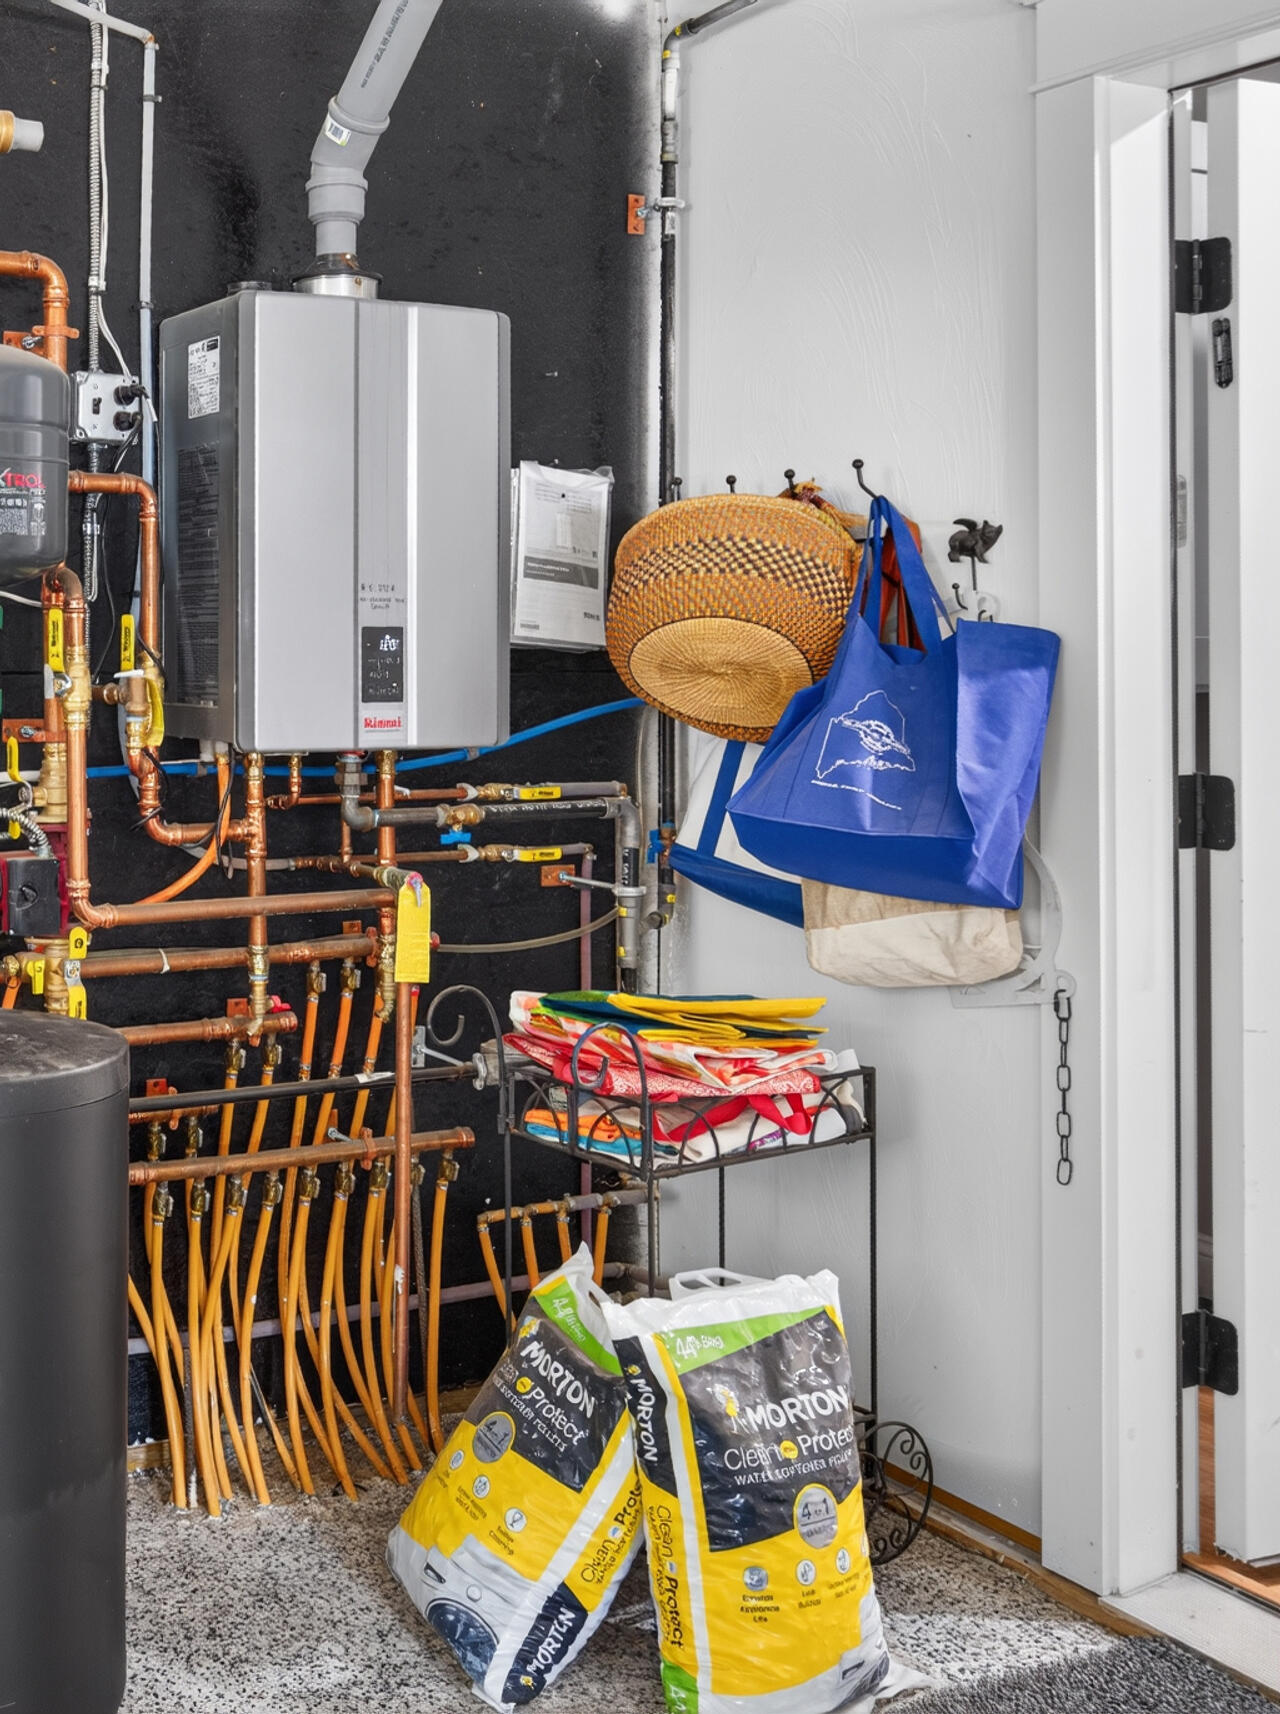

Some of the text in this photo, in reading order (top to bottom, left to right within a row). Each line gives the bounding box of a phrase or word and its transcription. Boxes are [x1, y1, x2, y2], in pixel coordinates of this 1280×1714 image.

[363, 716, 402, 729] Rinnai
[521, 1340, 596, 1418] MORTON
[744, 1386, 849, 1432] MORTON
[524, 1382, 588, 1446] Protect
[629, 1377, 659, 1462] MORTON
[723, 1443, 783, 1470] Clean
[613, 1486, 642, 1526] Prote
[656, 1504, 674, 1558] Clean
[665, 1575, 684, 1648] Protect
[526, 1606, 577, 1677] MORTON
